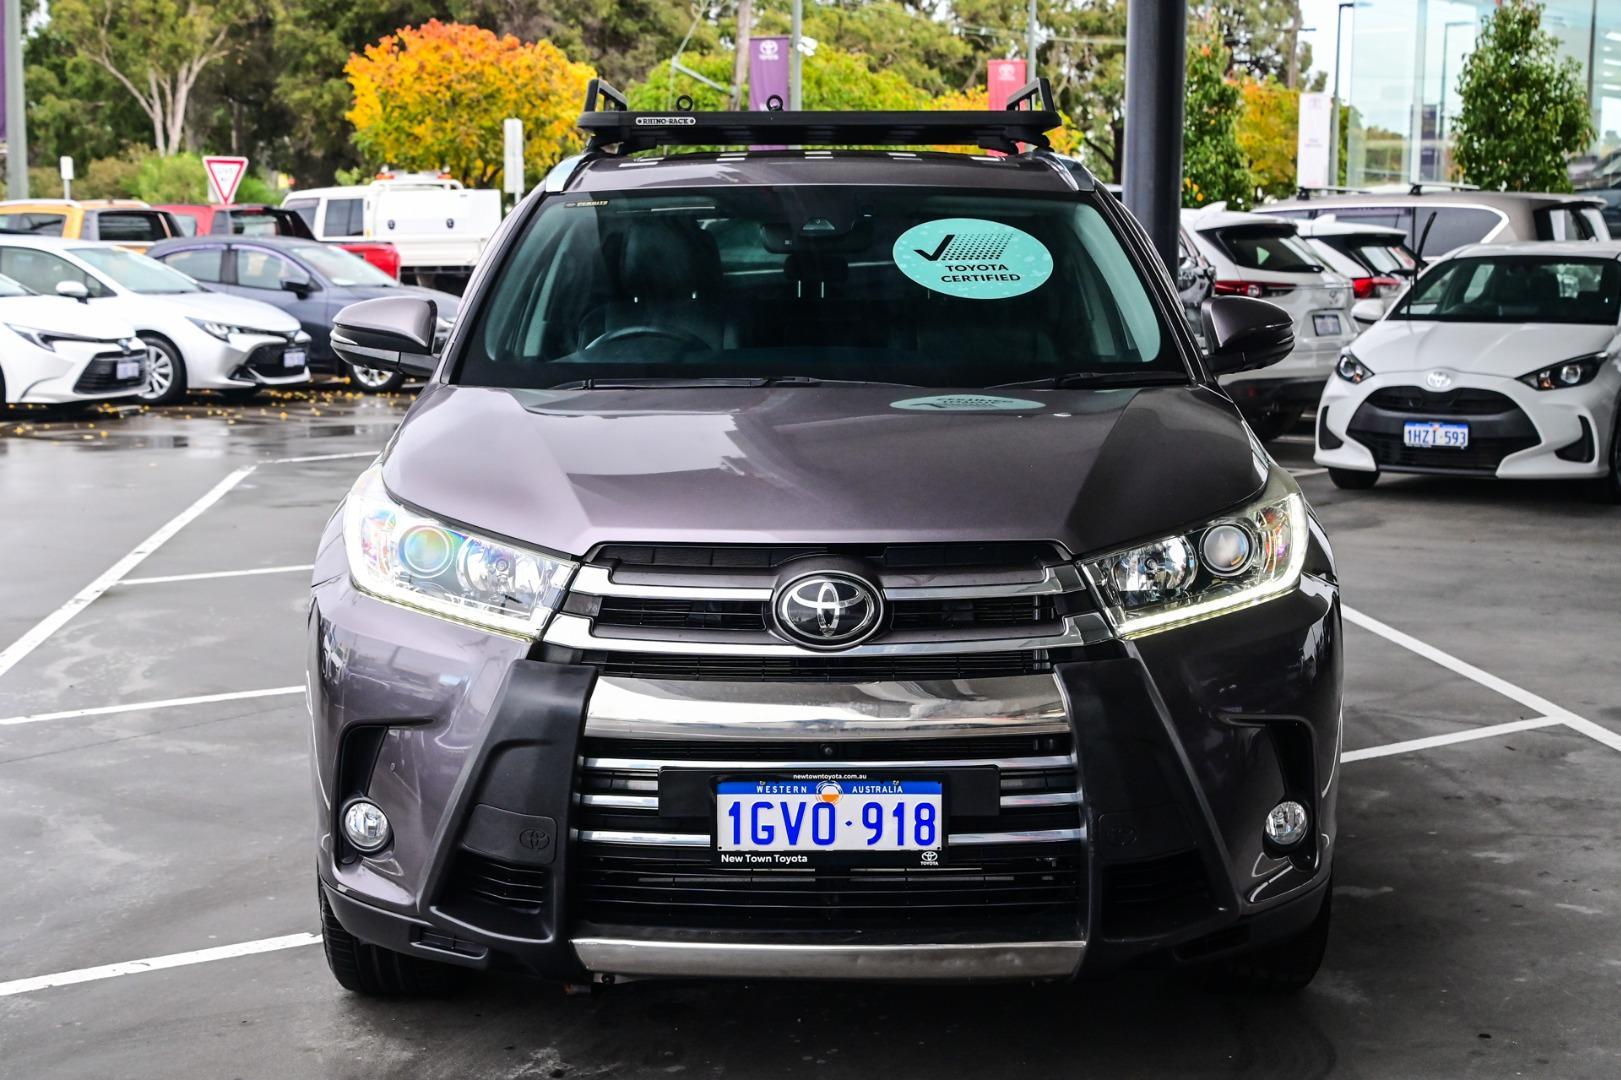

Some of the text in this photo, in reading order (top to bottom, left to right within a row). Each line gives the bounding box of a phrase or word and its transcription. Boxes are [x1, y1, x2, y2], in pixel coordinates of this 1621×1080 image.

[945, 264, 1008, 272] TOYOTA
[941, 274, 1020, 282] CERTIFIED
[756, 785, 903, 793] WESTERN AUSTRALIA
[721, 854, 808, 864] New Town Toyota
